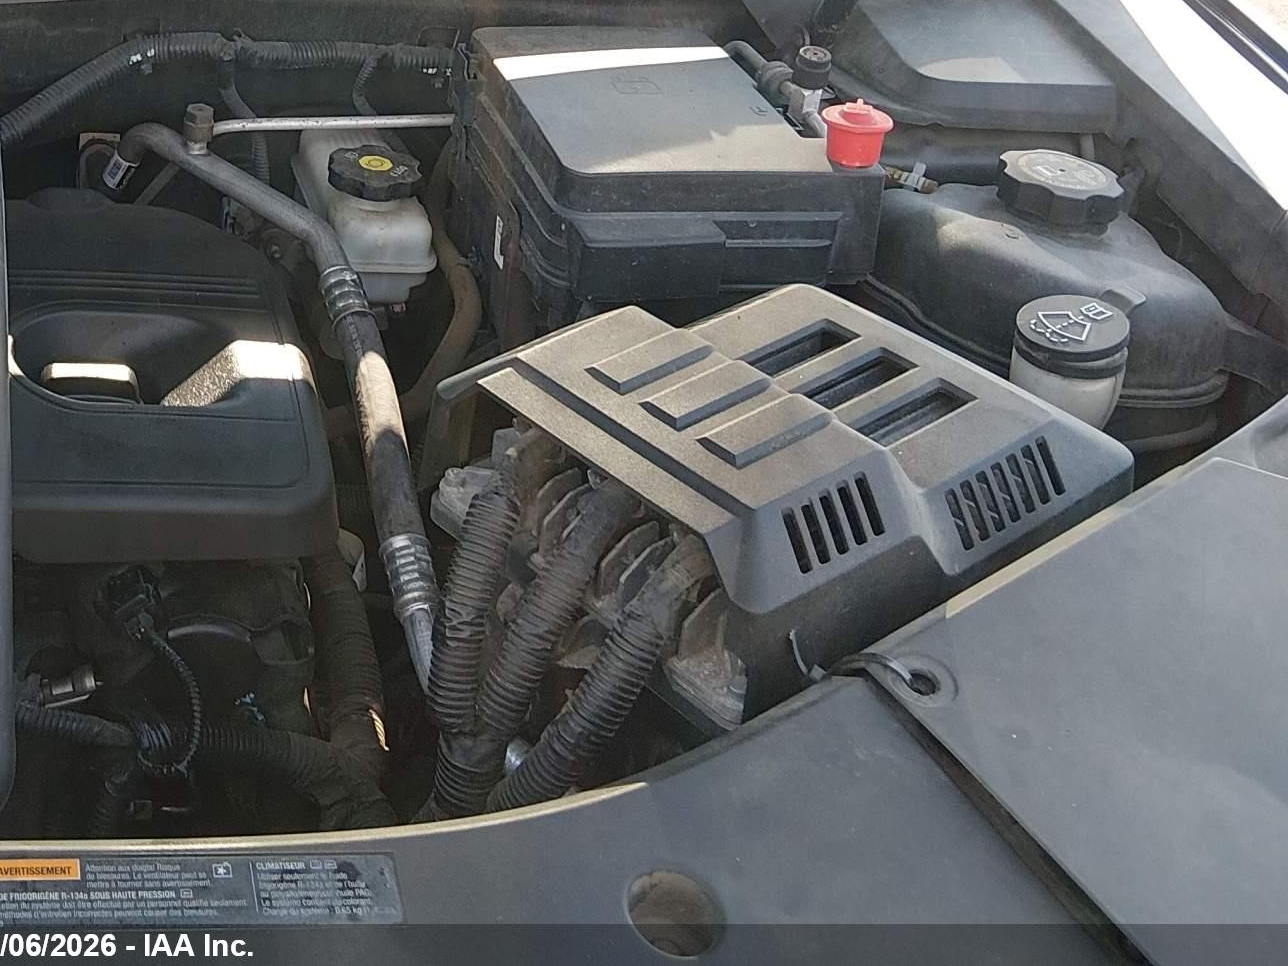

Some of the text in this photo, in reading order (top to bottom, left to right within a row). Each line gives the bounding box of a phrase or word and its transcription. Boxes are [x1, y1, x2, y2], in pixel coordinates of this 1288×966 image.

[255, 862, 306, 870] CLIMATISEUR
[61, 891, 89, 900] R-134a
[90, 890, 111, 900] SOUS
[112, 890, 137, 899] HAUTE
[138, 890, 176, 899] PRESSION
